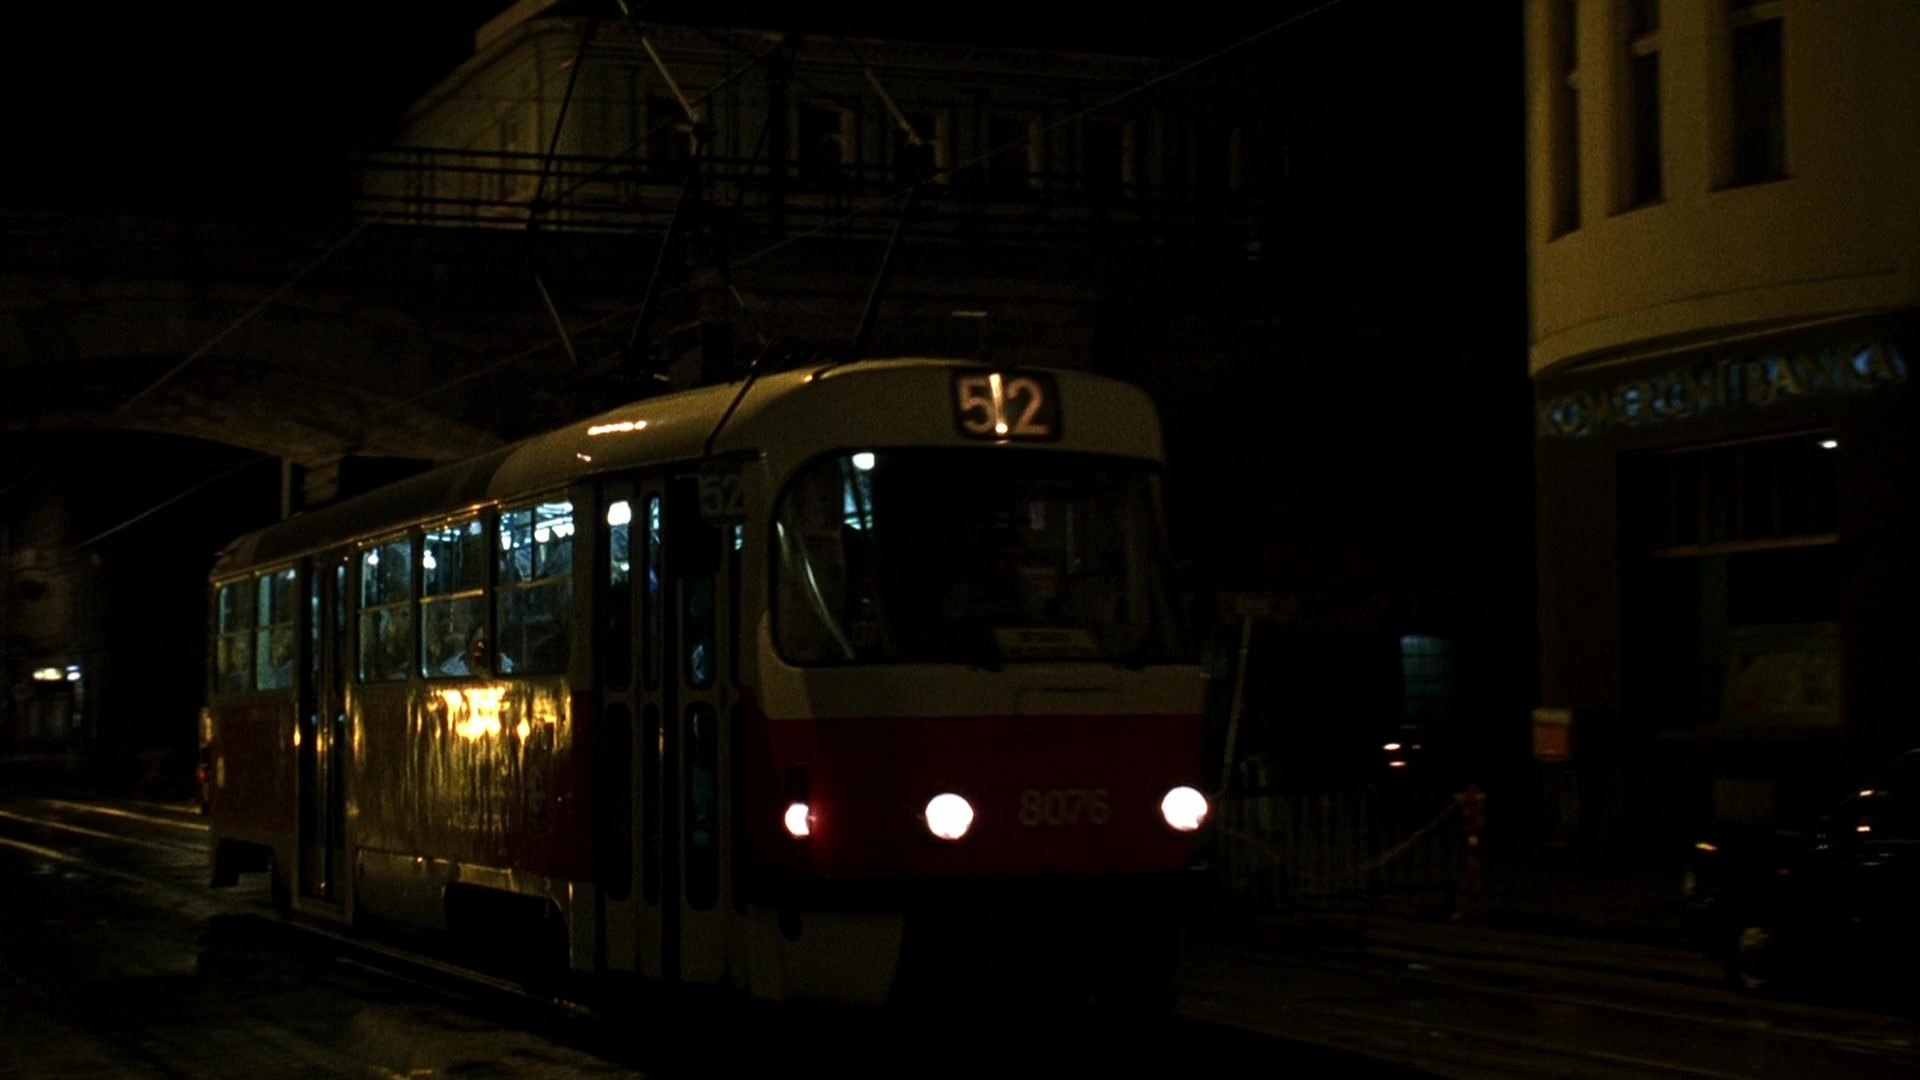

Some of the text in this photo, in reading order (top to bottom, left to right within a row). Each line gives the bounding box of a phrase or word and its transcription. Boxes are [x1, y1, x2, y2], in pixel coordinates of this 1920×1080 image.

[958, 375, 1049, 436] 52
[701, 474, 744, 516] 52
[1018, 787, 1112, 827] 8076
